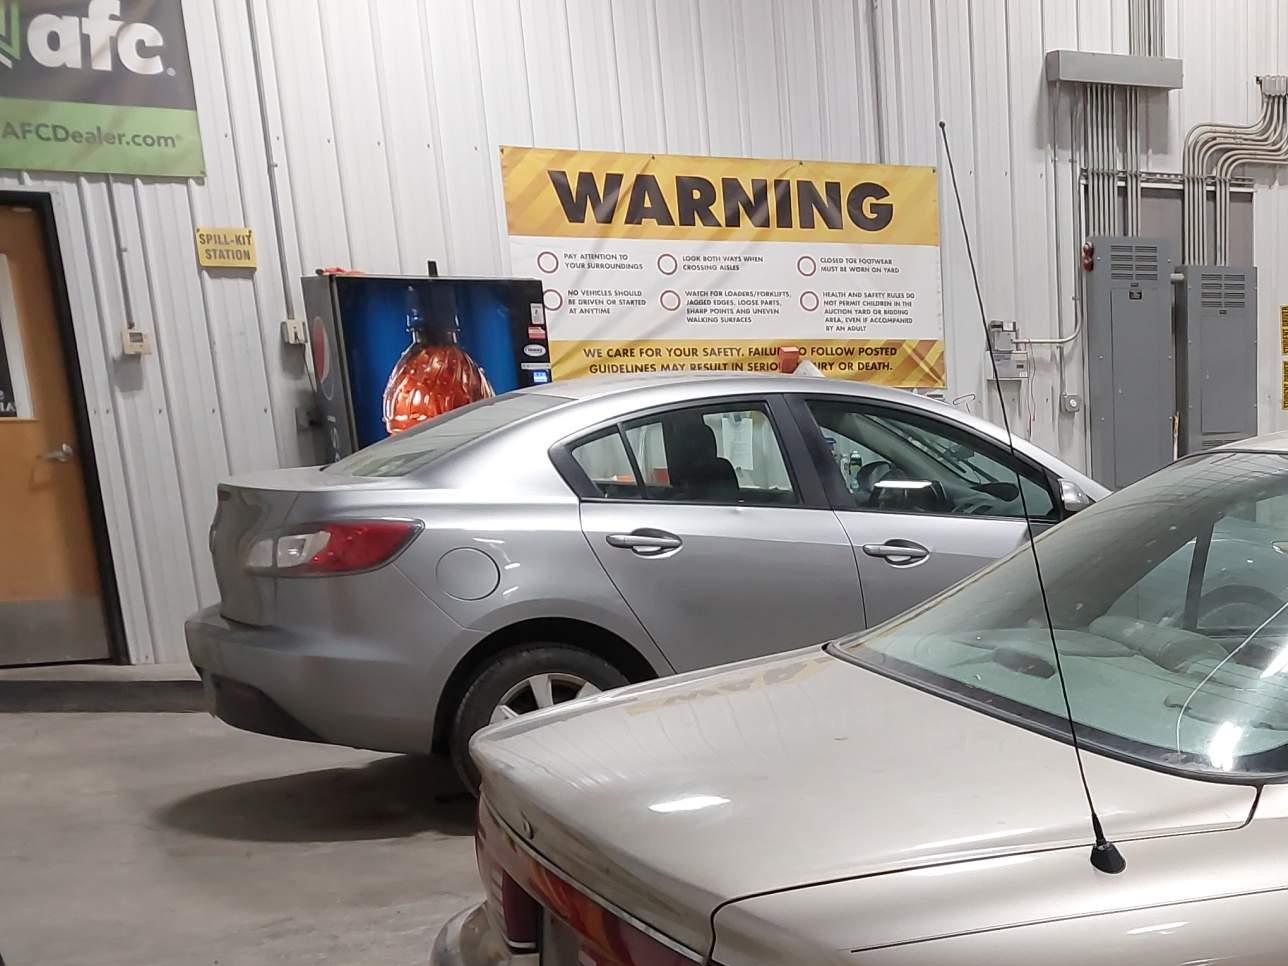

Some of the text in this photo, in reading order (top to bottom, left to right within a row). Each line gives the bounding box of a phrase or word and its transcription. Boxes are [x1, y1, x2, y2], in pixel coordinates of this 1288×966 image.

[547, 170, 894, 232] WARNING
[199, 233, 252, 246] SPILL-KIT
[205, 249, 251, 261] STATION
[587, 262, 644, 270] SURROUNDINGS
[580, 289, 613, 297] VEHICLES
[583, 348, 603, 358] WE
[606, 347, 635, 358] CARE
[639, 347, 662, 358] FOR
[665, 347, 699, 357] YOUR
[702, 347, 745, 357] SAFETY.
[748, 346, 780, 357] FAILU
[811, 346, 855, 356] FOLLOW
[857, 346, 897, 356] POSTED
[589, 362, 657, 374] GUIDELINES
[661, 363, 686, 371] MAY
[690, 362, 729, 371] RESULT
[731, 362, 743, 371] IN
[747, 361, 780, 371] SERIO
[838, 361, 854, 371] OR
[858, 361, 893, 371] DEATH.
